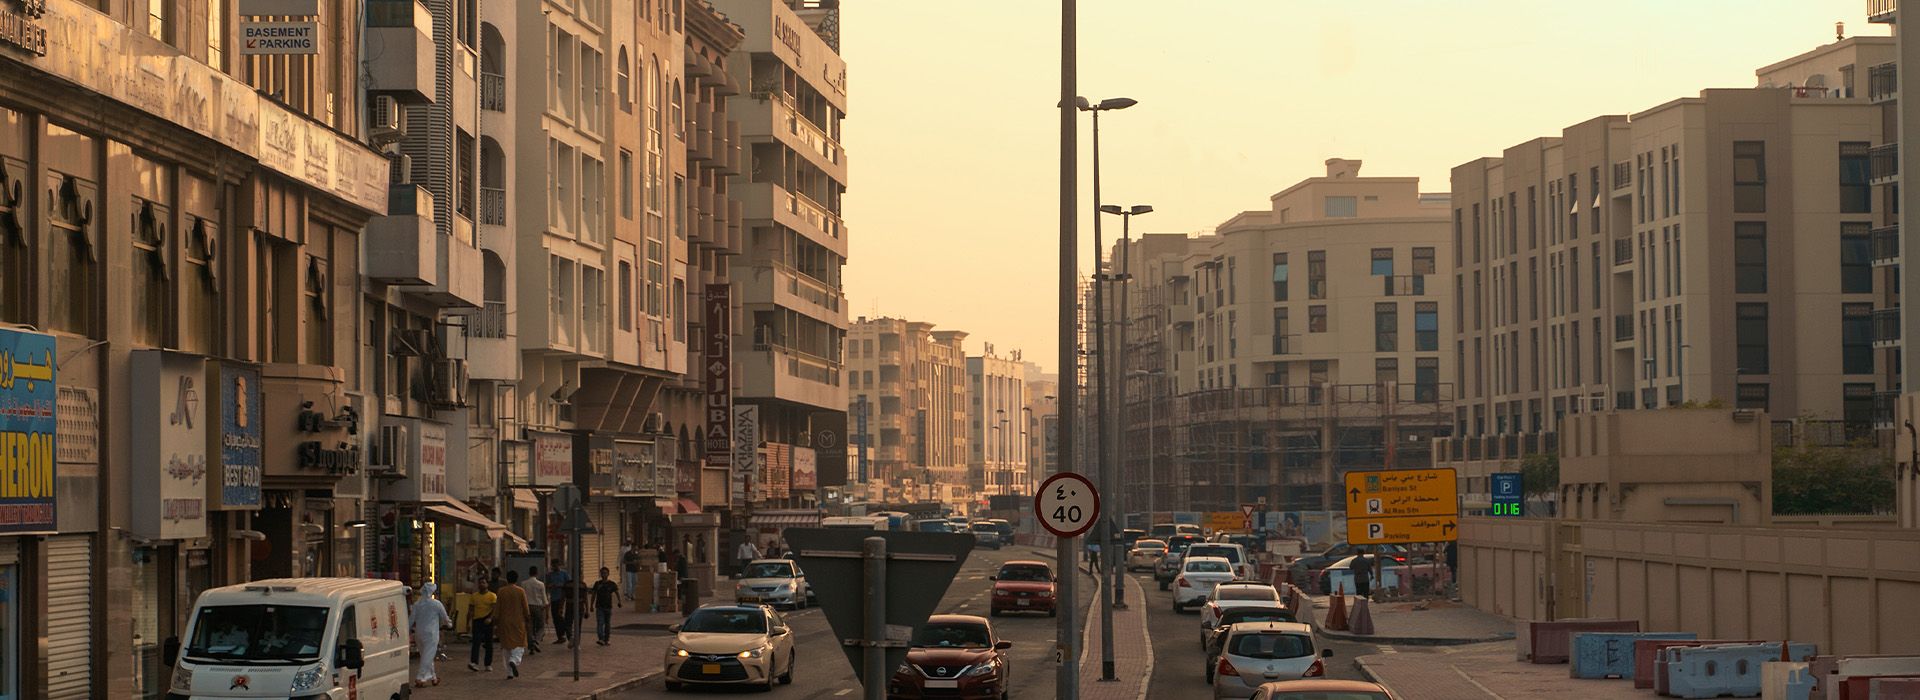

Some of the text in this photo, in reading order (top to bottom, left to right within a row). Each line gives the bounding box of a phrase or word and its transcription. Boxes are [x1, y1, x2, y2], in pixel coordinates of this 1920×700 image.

[246, 28, 311, 37] BASEMENT
[259, 39, 311, 48] PARKING
[709, 379, 728, 437] JUBA
[708, 439, 728, 449] HOTEL
[738, 407, 753, 472] KHAZANA
[225, 464, 241, 487] BEST
[243, 465, 259, 487] GOLD
[1503, 482, 1511, 492] P
[1052, 505, 1082, 523] 40
[1494, 502, 1520, 515] 0116
[1369, 524, 1380, 538] P
